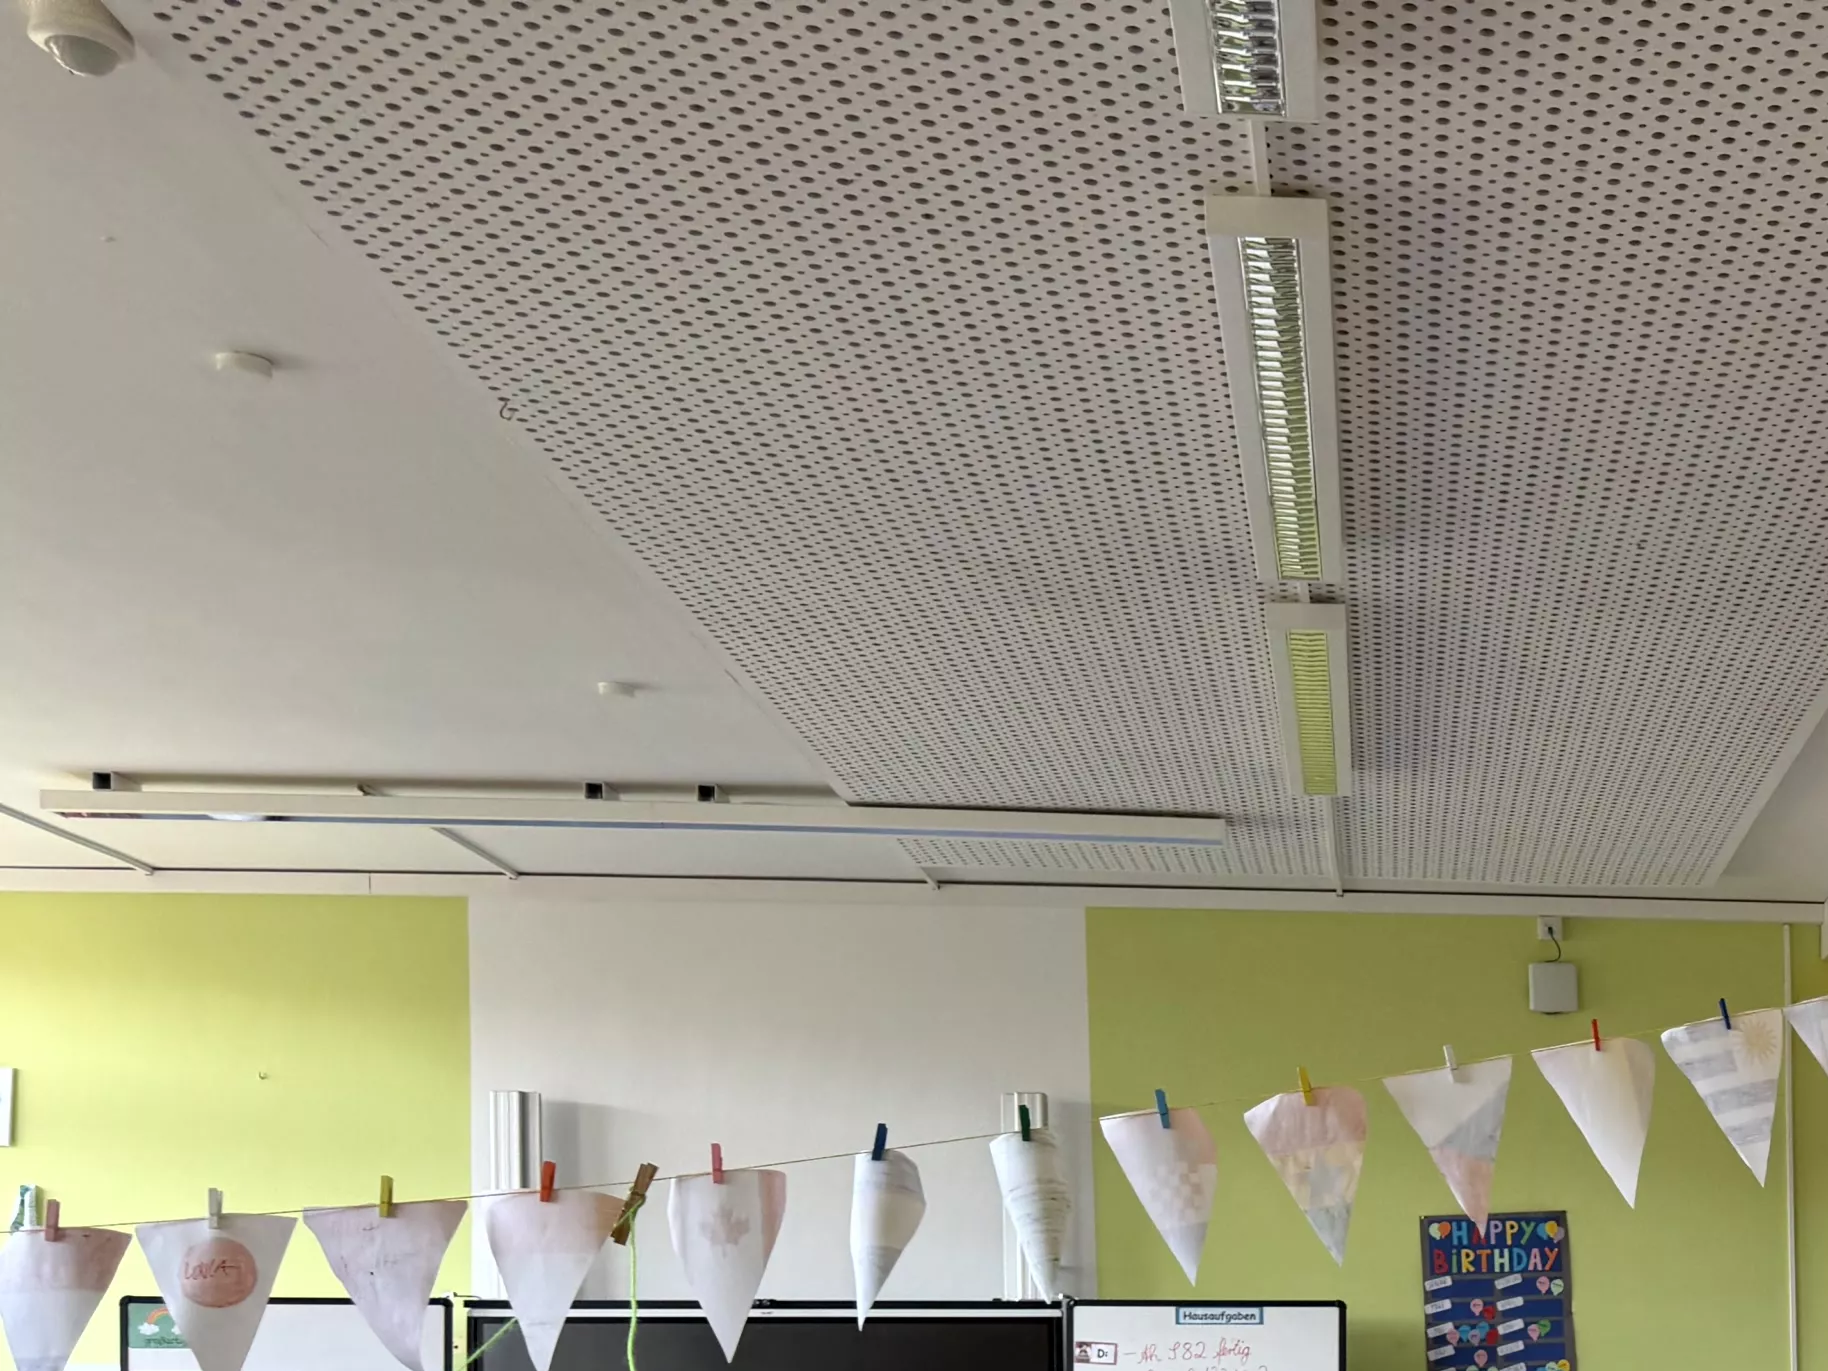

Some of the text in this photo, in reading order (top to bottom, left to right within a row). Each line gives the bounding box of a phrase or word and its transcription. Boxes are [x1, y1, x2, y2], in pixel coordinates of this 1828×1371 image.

[1452, 1220, 1535, 1245] HAPPY
[1183, 1309, 1256, 1323] Hausaufgaben
[1097, 1348, 1108, 1359] D:
